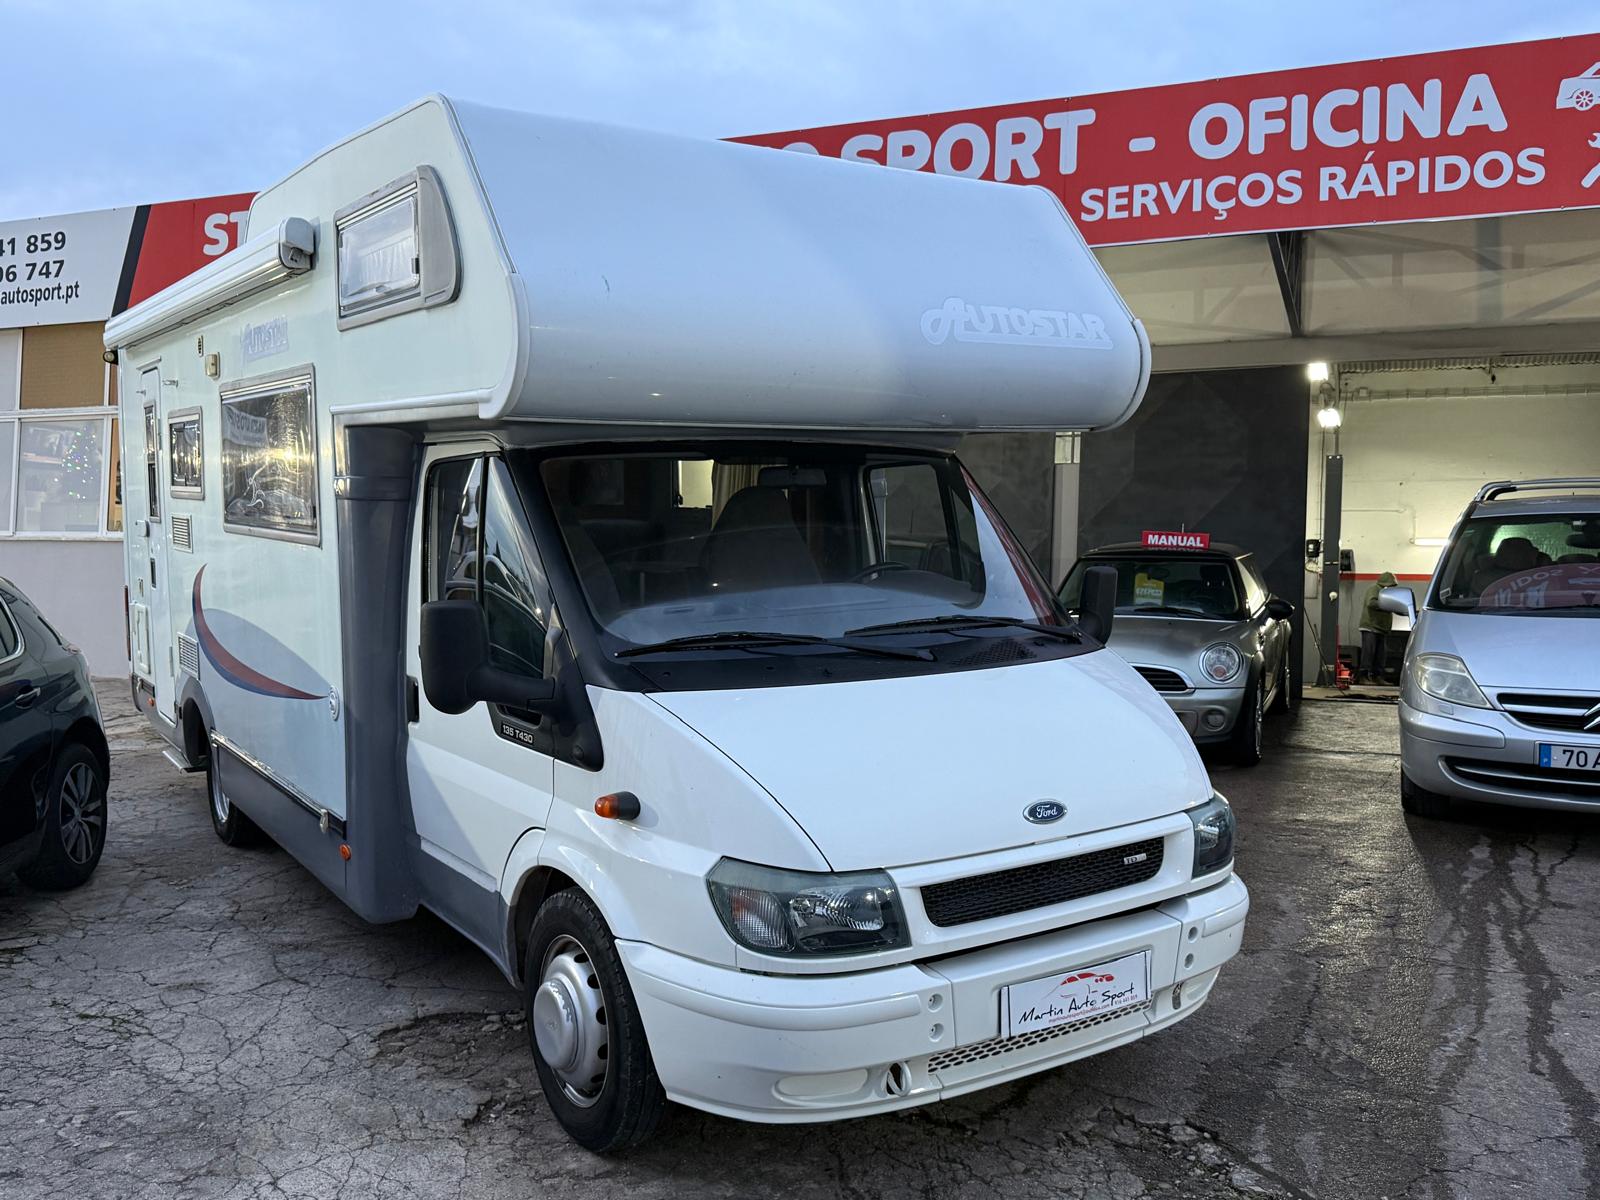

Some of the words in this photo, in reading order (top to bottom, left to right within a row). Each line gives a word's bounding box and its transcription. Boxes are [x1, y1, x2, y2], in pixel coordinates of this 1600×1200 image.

[1188, 73, 1508, 160] OFICINA
[1081, 169, 1303, 222] SERVIÇOS
[1319, 147, 1546, 202] RÁPIDOS
[26, 231, 66, 254] 859
[25, 259, 65, 281] 747
[0, 280, 80, 307] autosport.pt
[1147, 534, 1204, 548] MANUAL
[502, 724, 514, 737] 135
[514, 729, 533, 744] T430
[1562, 749, 1588, 768] 70
[1036, 804, 1058, 818] Ford
[1018, 1004, 1063, 1025] Martin
[1068, 995, 1097, 1014] Auto
[1101, 982, 1135, 1006] Sport
